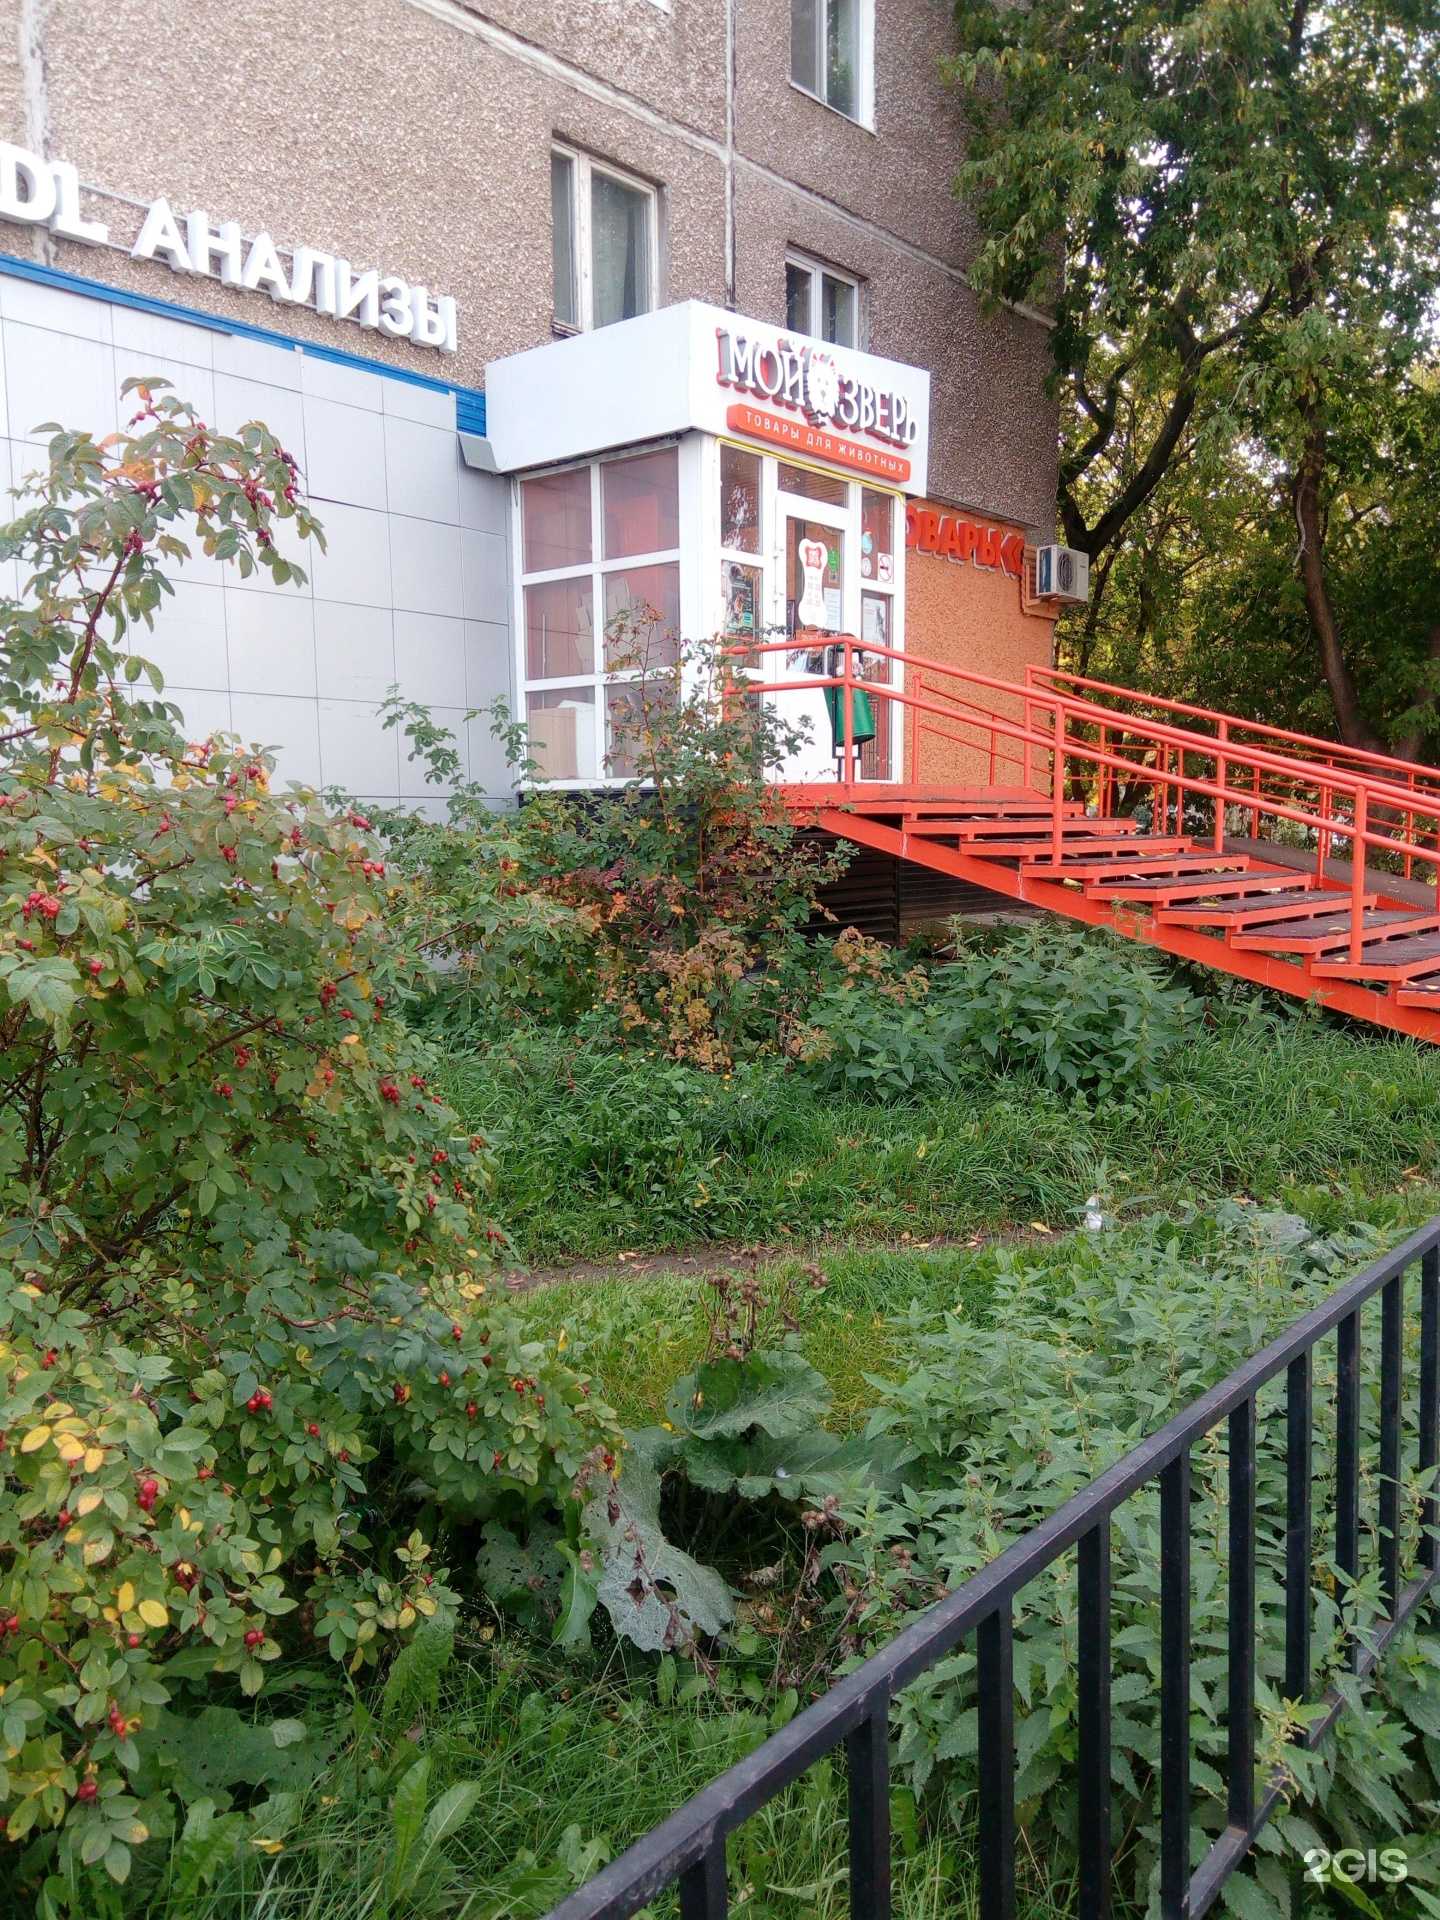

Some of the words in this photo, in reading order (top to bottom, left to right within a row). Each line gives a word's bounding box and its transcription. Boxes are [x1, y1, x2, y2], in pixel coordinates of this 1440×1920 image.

[130, 196, 458, 354] АНАЛИЗЫ
[716, 328, 808, 411] МОЙ
[836, 375, 921, 450] ЗВЕРЬ
[745, 410, 801, 440] ТОВАРЫ
[806, 433, 833, 451] ДЛЯ
[837, 443, 905, 474] ЖИВОТНЫХ
